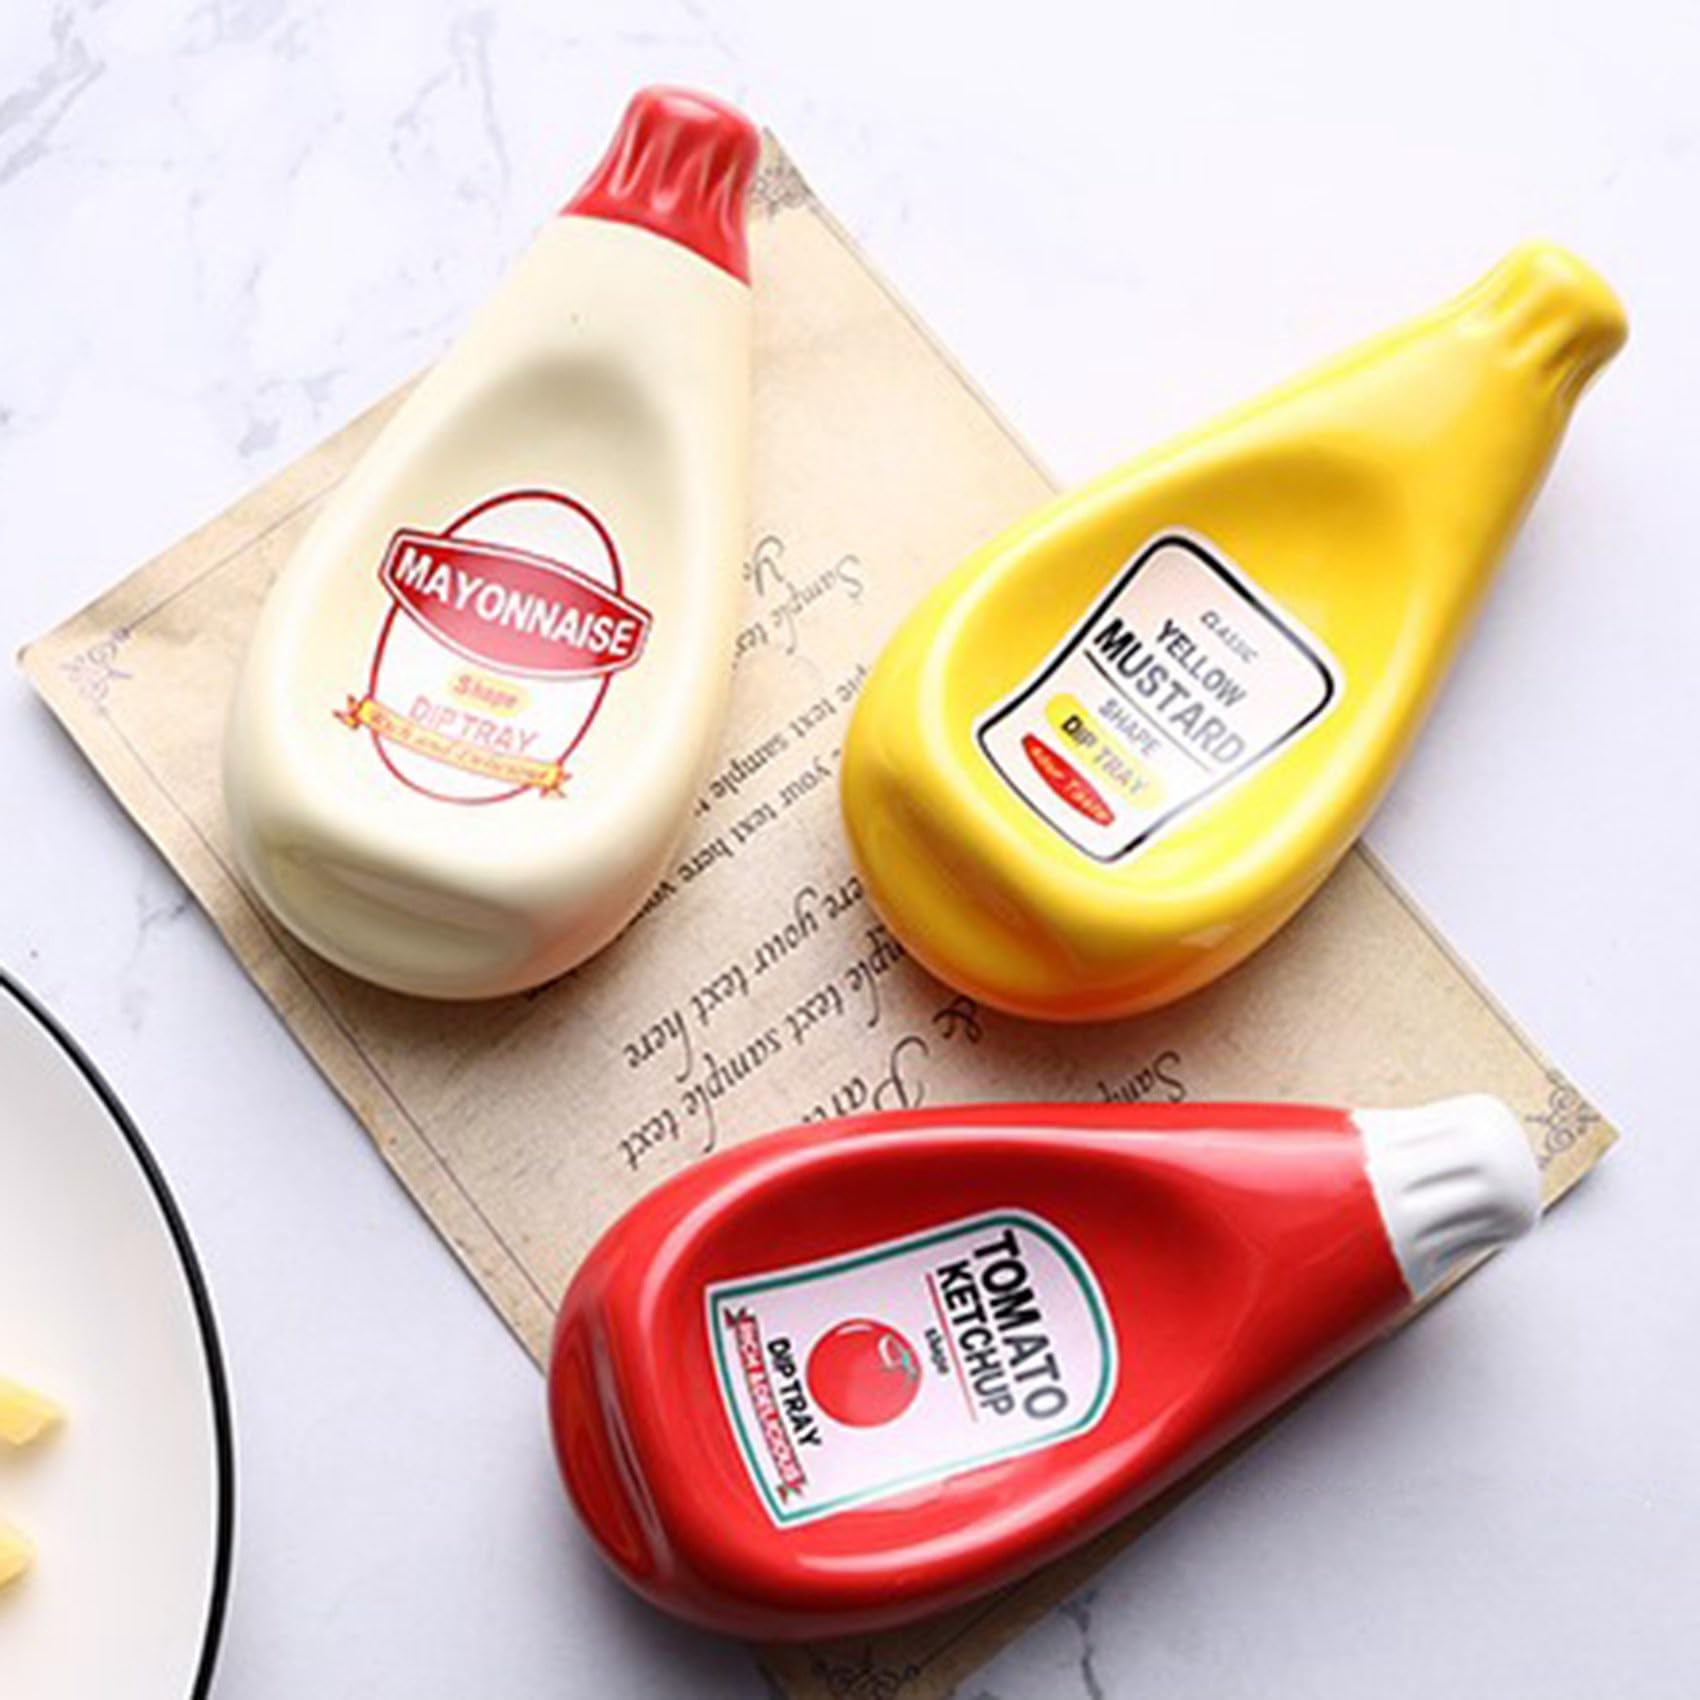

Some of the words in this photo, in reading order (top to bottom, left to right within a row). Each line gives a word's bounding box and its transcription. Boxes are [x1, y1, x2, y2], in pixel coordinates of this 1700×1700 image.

[395, 548, 636, 656] MAYONNAISE
[774, 554, 865, 655] Sample
[1200, 610, 1260, 664] CLASSIC
[1093, 617, 1247, 765] MUSTARD
[1155, 618, 1247, 709] YELLOW
[409, 695, 455, 732] DIP
[460, 713, 540, 753] TRAY
[1061, 714, 1098, 750] DIP
[1091, 744, 1149, 796] TRAY
[1099, 698, 1161, 757] SHAPE
[710, 733, 791, 804] sample
[777, 755, 832, 808] your
[729, 801, 778, 845] text
[676, 835, 736, 885] here
[823, 876, 863, 915] ere
[754, 885, 820, 974] your
[694, 966, 750, 1024] text
[786, 990, 847, 1040] text
[625, 1008, 690, 1084] here
[684, 1024, 784, 1154] sample
[617, 1113, 680, 1171] text
[767, 1337, 797, 1379] DIP
[936, 1259, 1015, 1417] KETCHUP
[973, 1228, 1069, 1420] TOMATO
[779, 1377, 823, 1448] TRAY
